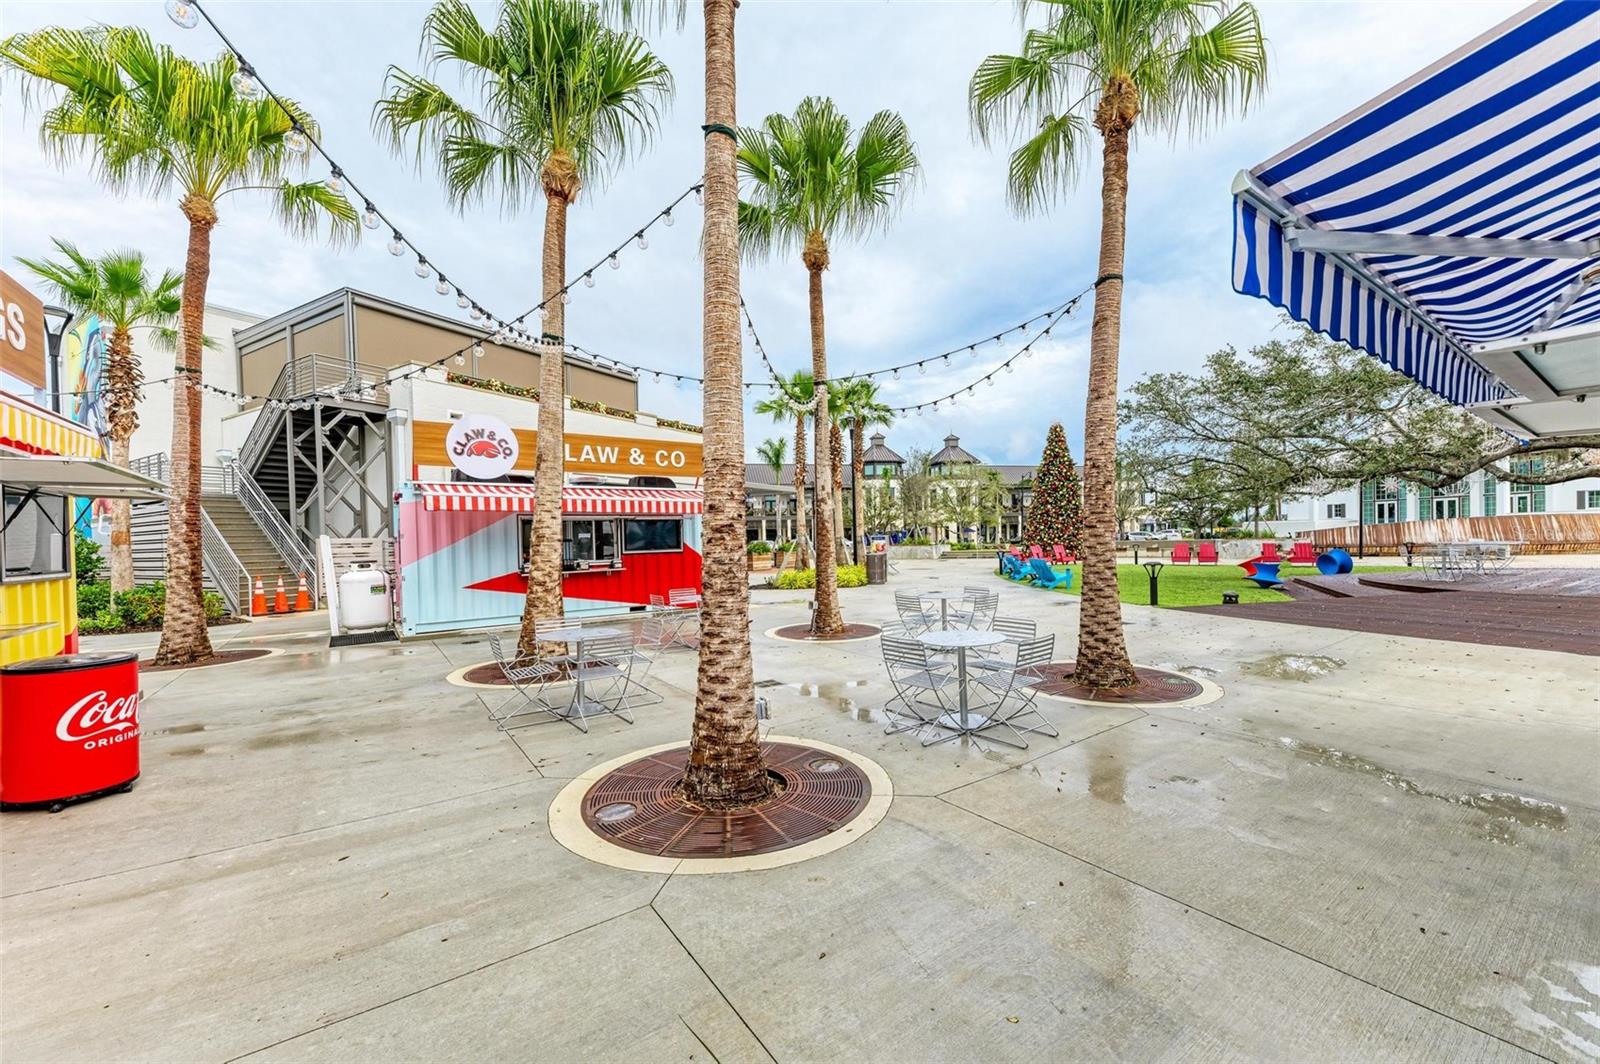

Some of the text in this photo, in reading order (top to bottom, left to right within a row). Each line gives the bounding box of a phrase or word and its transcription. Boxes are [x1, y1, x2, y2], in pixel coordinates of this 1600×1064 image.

[453, 427, 485, 456] CLAW
[487, 430, 497, 441] &
[629, 447, 646, 465] &
[655, 449, 686, 467] CO
